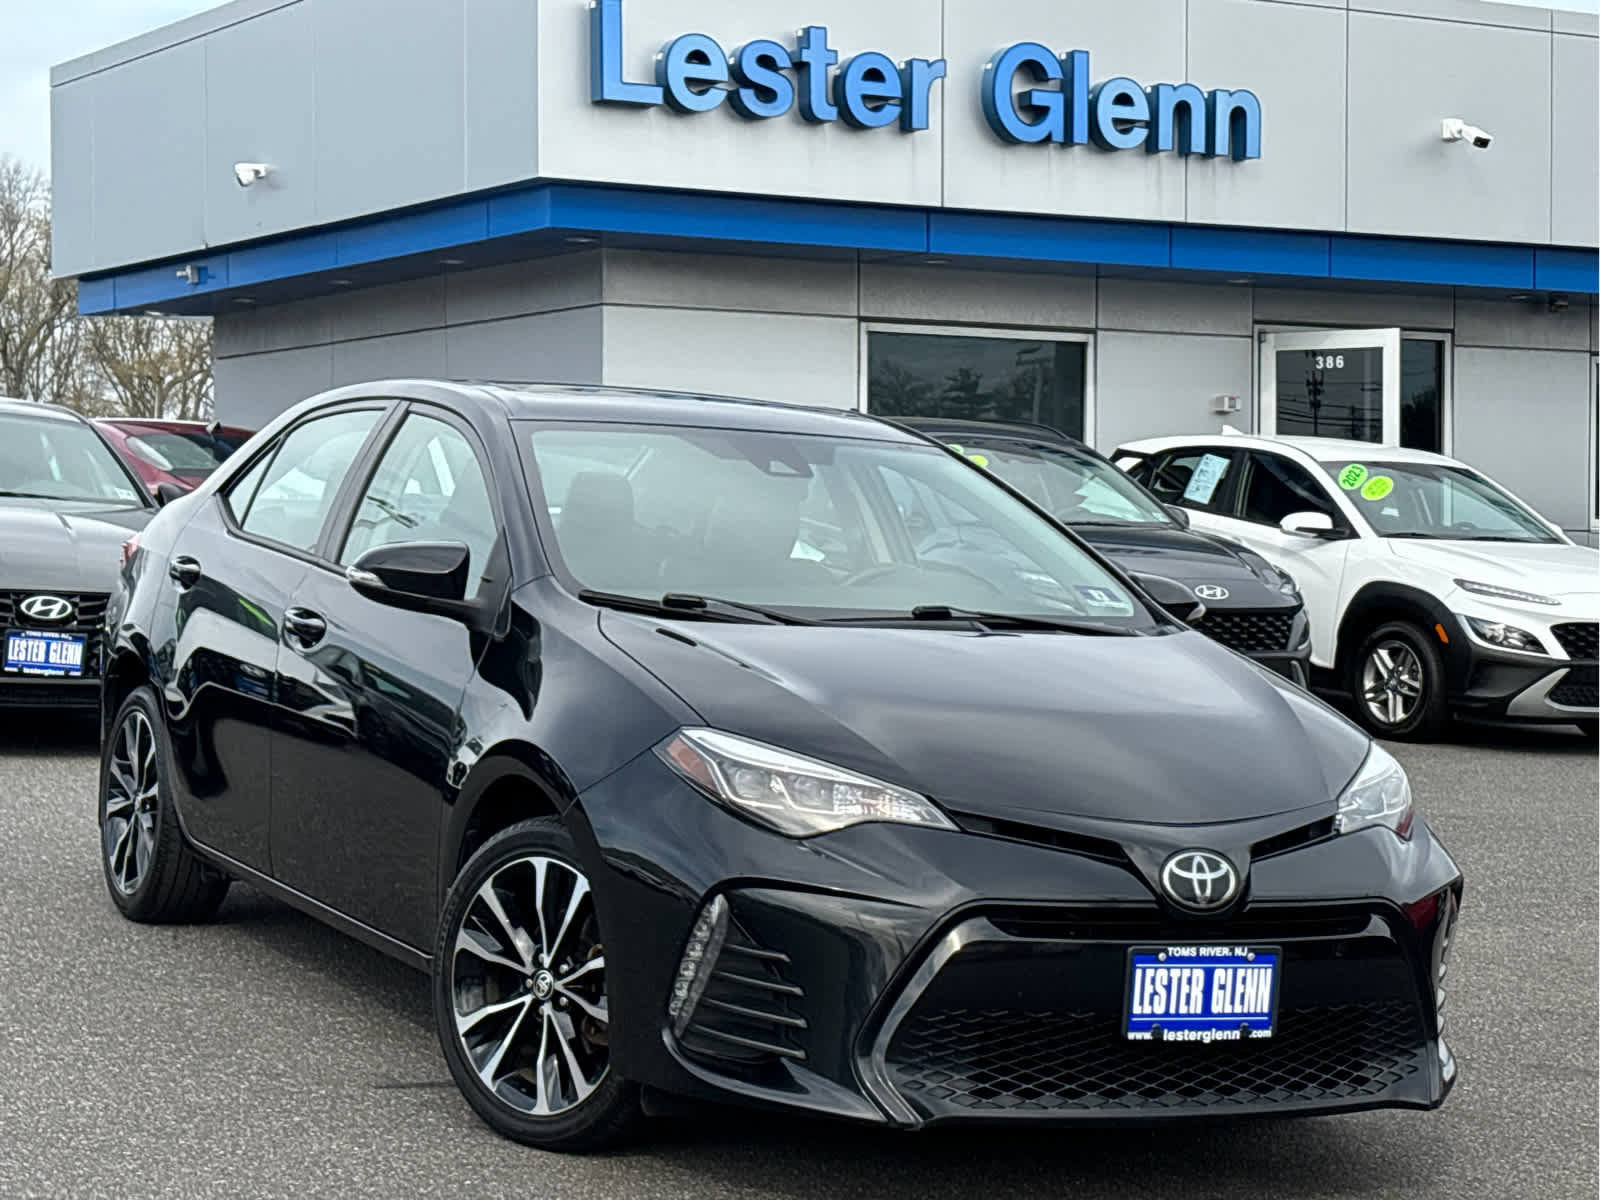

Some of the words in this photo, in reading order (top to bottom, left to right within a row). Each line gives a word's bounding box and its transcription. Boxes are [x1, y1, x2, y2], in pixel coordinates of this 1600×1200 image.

[590, 0, 946, 131] Lester
[981, 42, 1262, 161] Glenn
[1315, 355, 1345, 369] 386
[8, 638, 47, 664] LESTER
[49, 641, 83, 666] GLENN
[1167, 947, 1197, 957] TOMS
[1234, 947, 1248, 957] NJ
[1132, 968, 1205, 1015] LESTER
[1211, 968, 1272, 1014] GLENN
